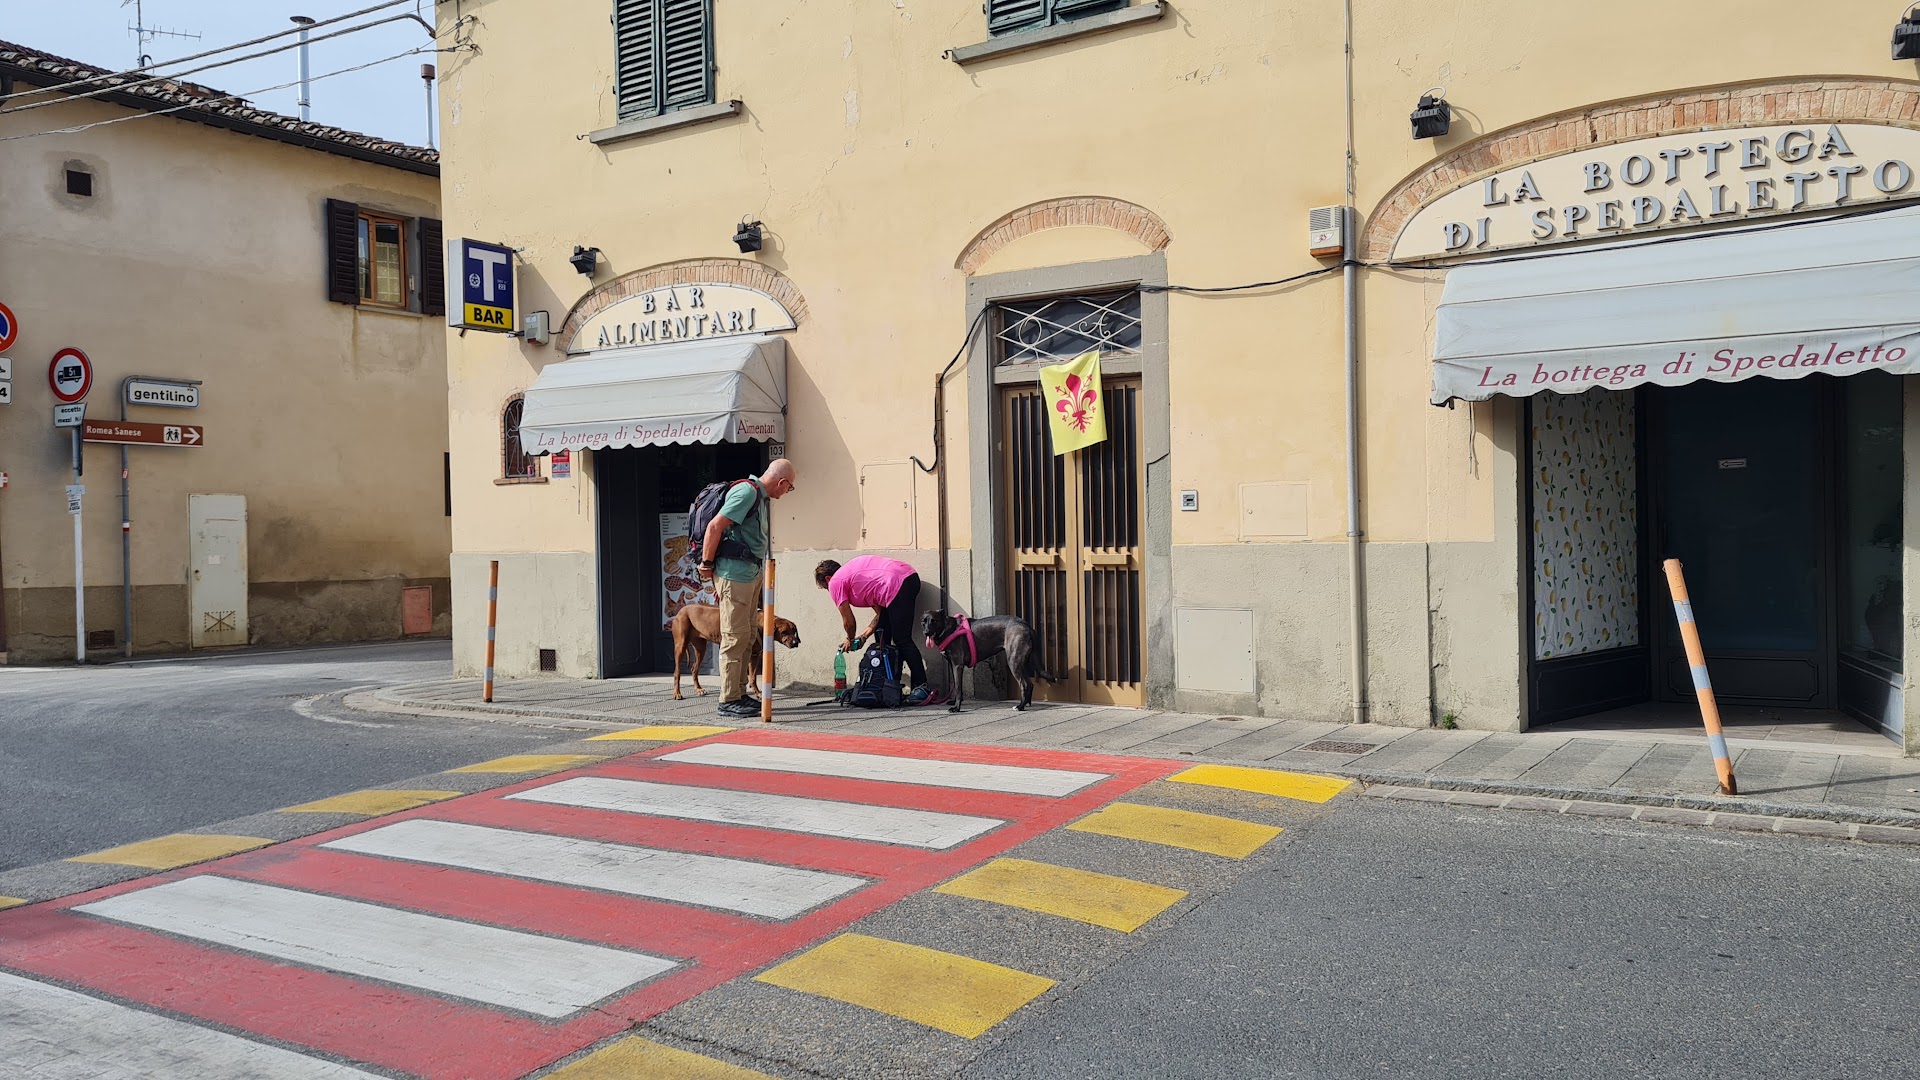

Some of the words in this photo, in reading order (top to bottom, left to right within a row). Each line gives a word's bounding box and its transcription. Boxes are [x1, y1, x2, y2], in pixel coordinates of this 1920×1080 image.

[1482, 169, 1543, 208] LA
[1583, 124, 1855, 194] BOTTEGA
[1443, 216, 1491, 252] DI
[1530, 159, 1912, 240] SPEDALETTO
[468, 247, 507, 302] T
[642, 286, 705, 314] BAR
[473, 307, 505, 326] BAR
[597, 308, 756, 347] ALIMENTARI
[1477, 366, 1518, 388] La
[1531, 362, 1648, 385] bottega
[1662, 352, 1698, 375] di
[1706, 342, 1908, 378] Spedaletto
[134, 390, 194, 403] gentilino
[61, 406, 82, 414] eccetto
[86, 425, 113, 435] Romea
[114, 426, 142, 437] Sanese
[537, 432, 555, 447] La
[560, 427, 609, 447] bottega
[614, 426, 628, 441] di
[632, 423, 711, 442] Spedaletto
[736, 419, 776, 435] Alimentari
[770, 446, 783, 456] 103
